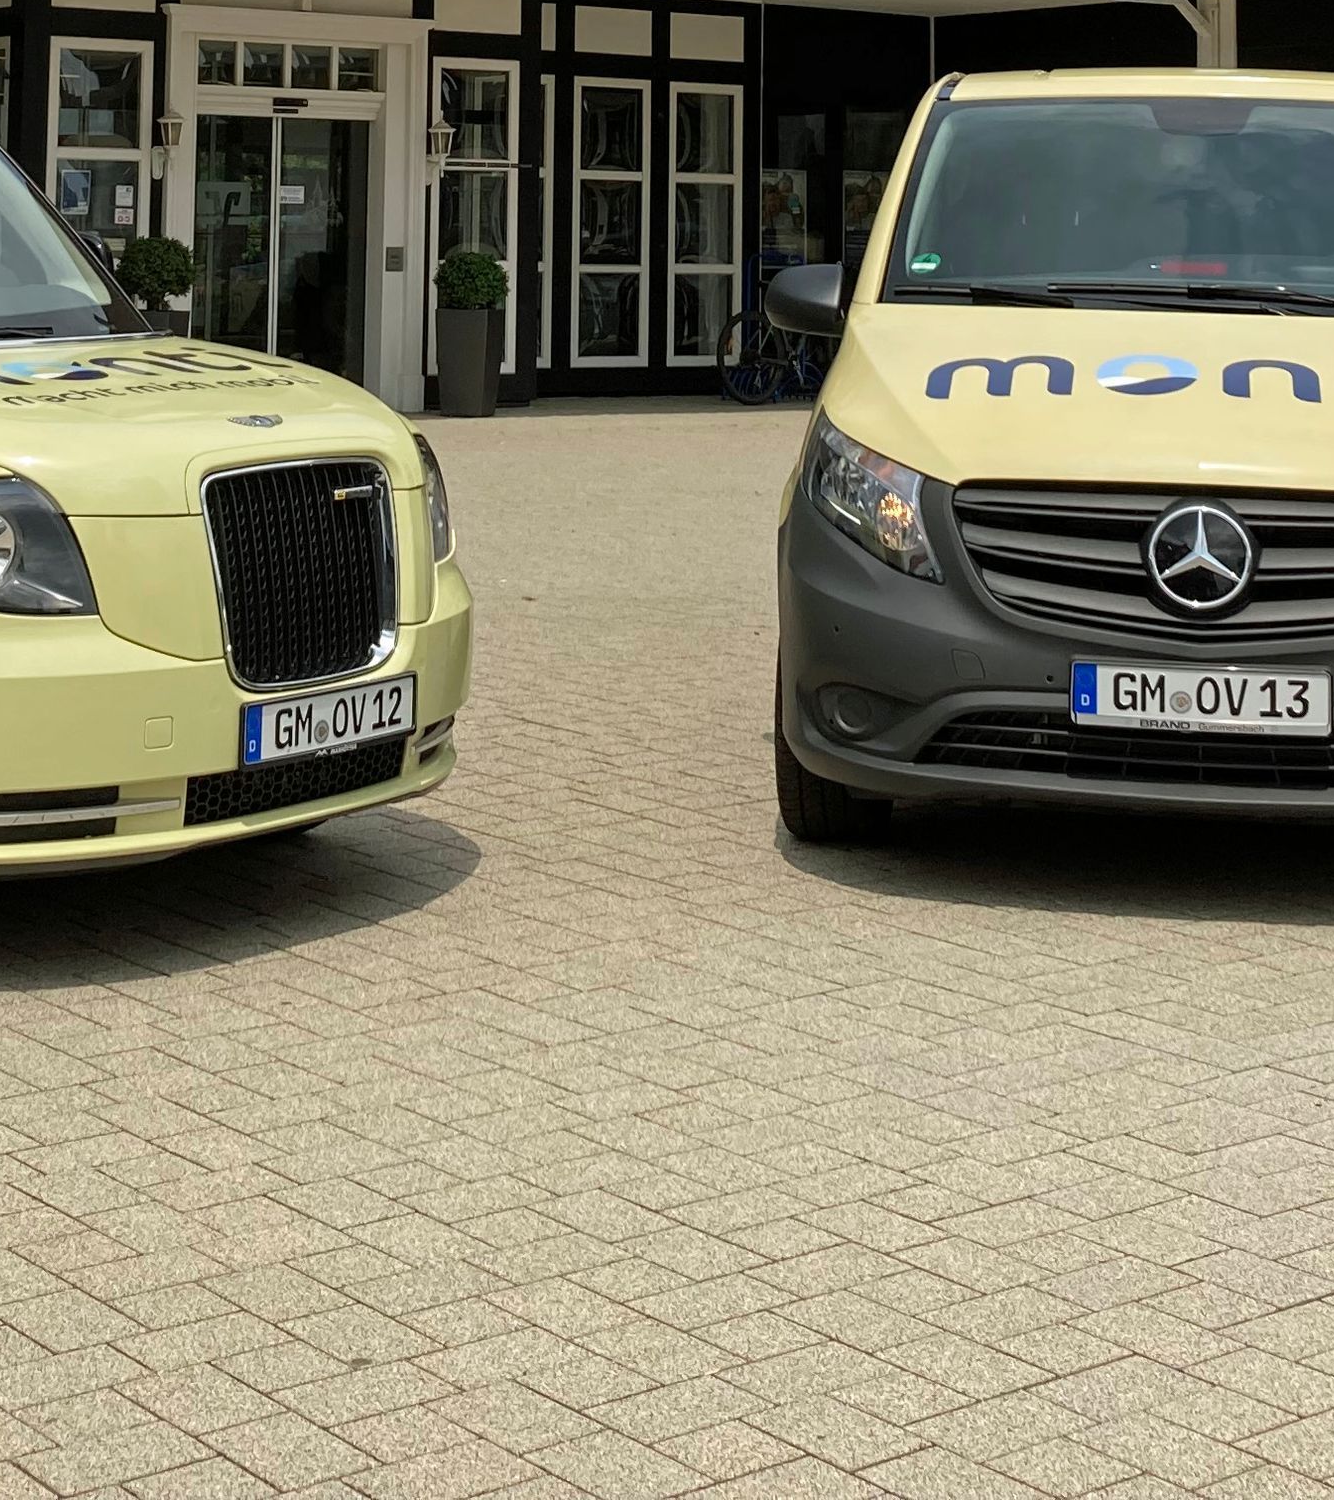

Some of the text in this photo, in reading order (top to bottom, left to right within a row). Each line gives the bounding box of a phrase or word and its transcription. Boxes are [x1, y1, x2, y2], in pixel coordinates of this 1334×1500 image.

[1, 386, 127, 407] macht
[124, 379, 209, 395] mich
[1080, 693, 1090, 706] D
[1112, 672, 1311, 719] GM OV 13
[274, 685, 402, 750] GM OV 12
[1139, 718, 1265, 733] BRAND Gummersbach
[248, 739, 257, 753] D
